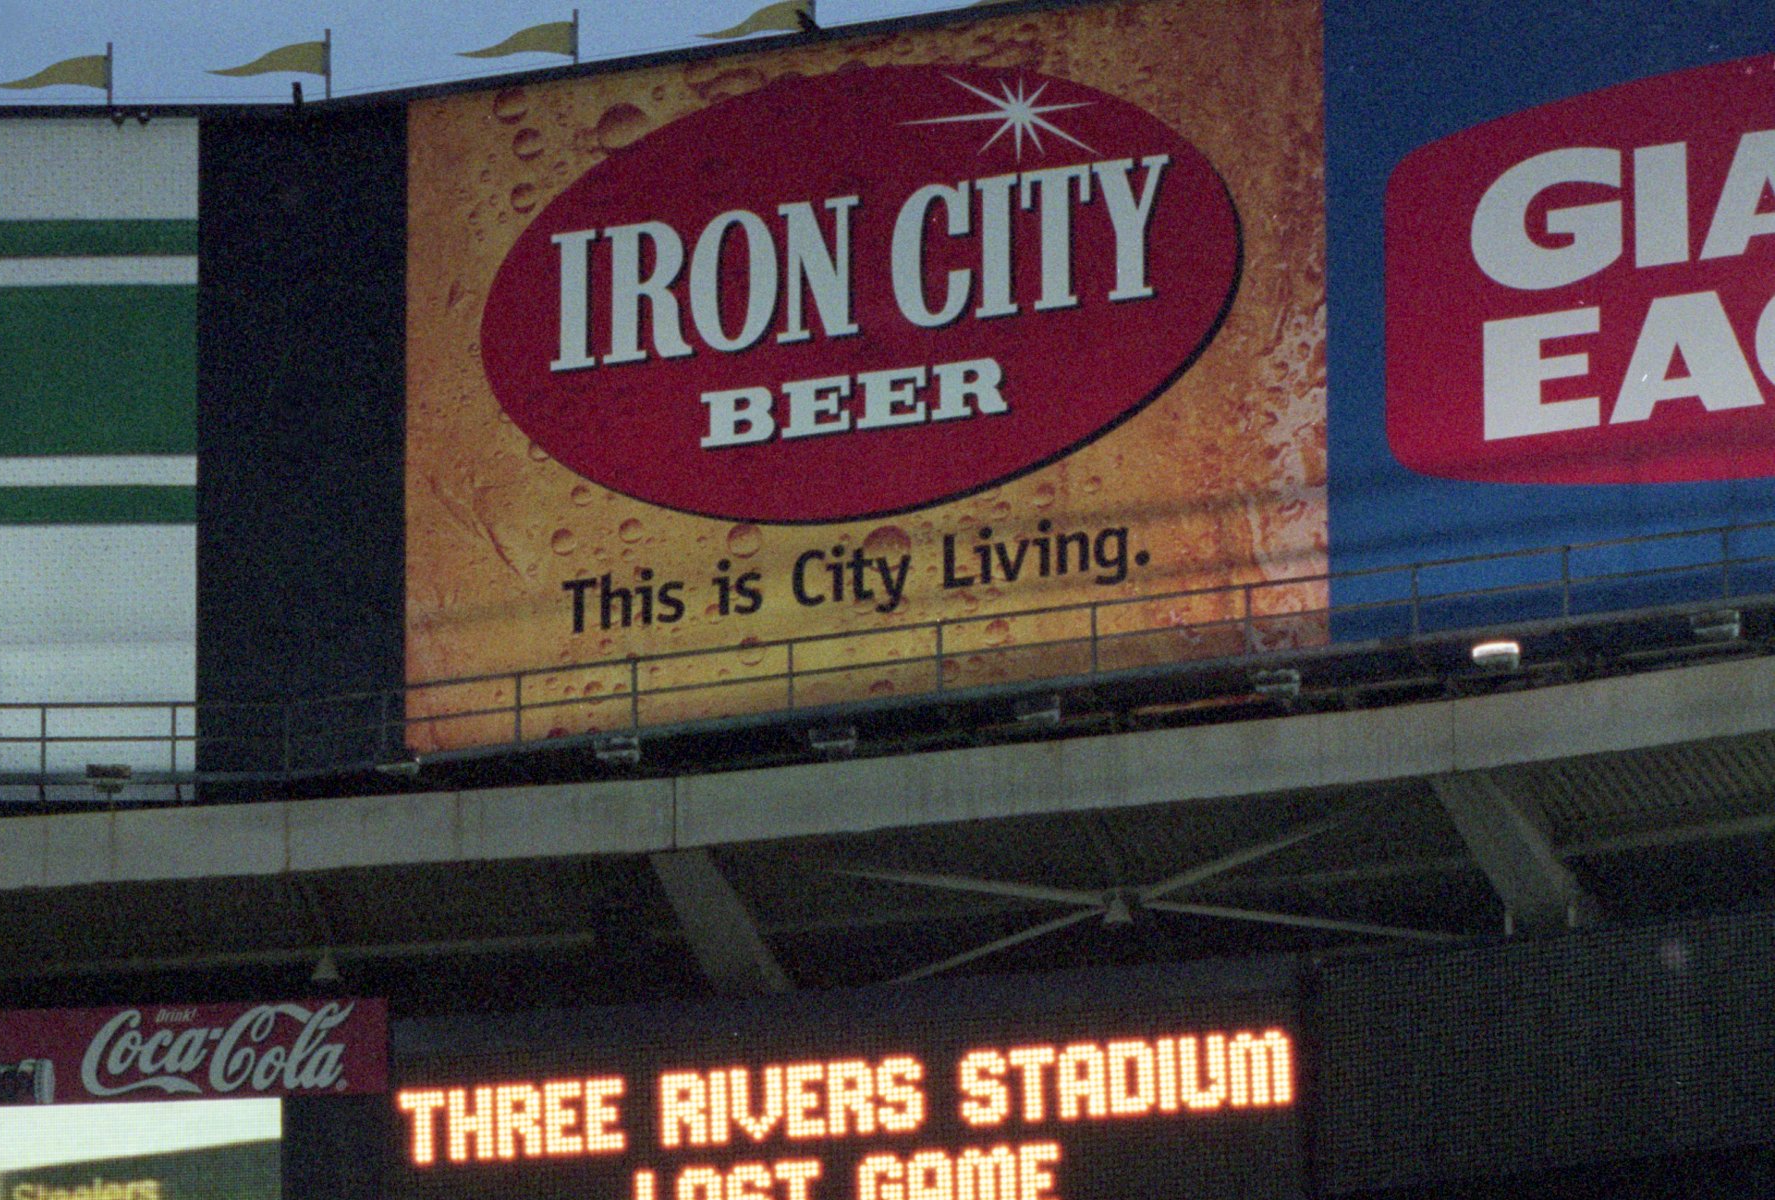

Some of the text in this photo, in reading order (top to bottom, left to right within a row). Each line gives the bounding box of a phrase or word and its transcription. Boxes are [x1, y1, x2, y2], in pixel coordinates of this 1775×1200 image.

[550, 155, 1170, 372] IRON CITY
[701, 358, 1008, 448] BEER
[1483, 291, 1775, 440] EA
[562, 519, 1150, 633] This is City Living.
[81, 1001, 355, 1096] Coca-Cola
[395, 1027, 1295, 1167] THREE RIVERS STADIUM
